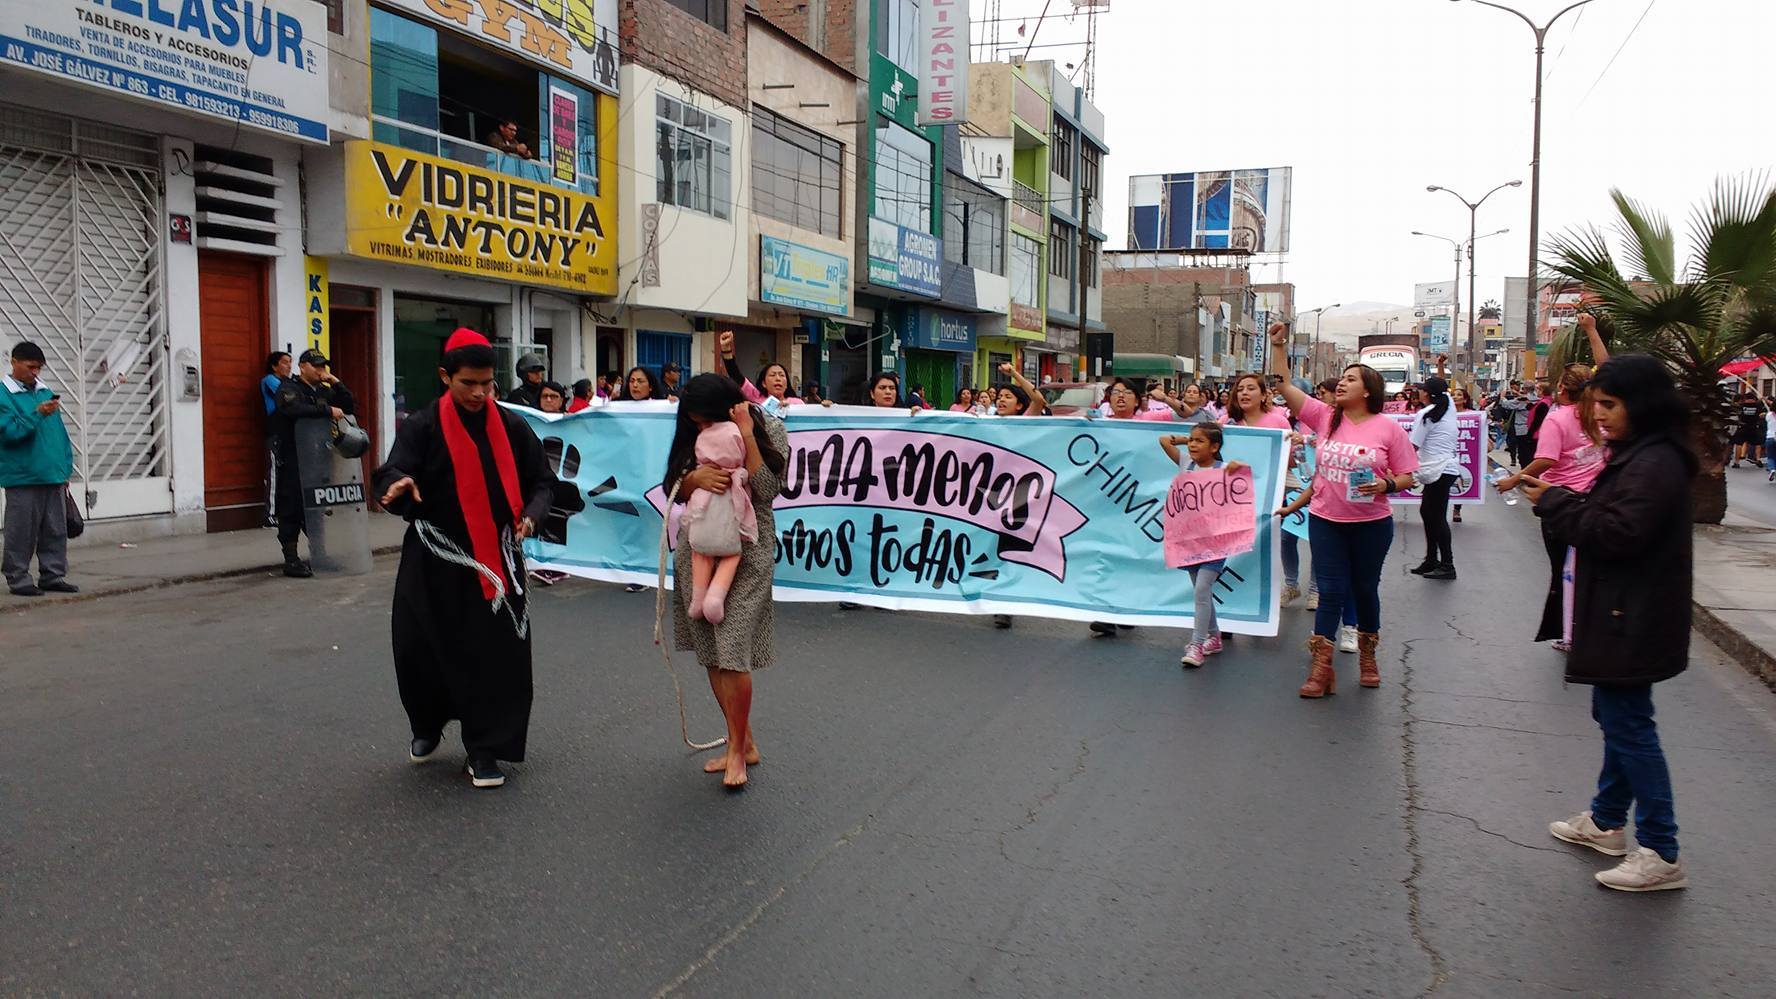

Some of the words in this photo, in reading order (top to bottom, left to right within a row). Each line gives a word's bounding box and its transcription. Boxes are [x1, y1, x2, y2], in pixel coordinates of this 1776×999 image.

[75, 8, 150, 40] TABLEROS
[154, 31, 163, 44] Y
[168, 37, 248, 70] ACCESORIOS
[79, 26, 110, 44] VENTA
[113, 36, 125, 48] DE
[127, 41, 182, 64] ACCESORIOS
[184, 58, 206, 72] PARA
[83, 0, 304, 69] LASUR
[423, 0, 573, 69] GYM
[6, 43, 28, 63] AV.
[31, 50, 63, 72] JOSÉ
[65, 58, 110, 85] GÁLVEZ
[158, 85, 183, 103] CEL.
[192, 72, 239, 96] TAPACANTO
[241, 86, 251, 98] EN
[253, 89, 286, 109] GENERAL
[370, 150, 605, 239] VIDRIERIA
[899, 254, 923, 280] GROUP
[940, 318, 969, 340] hortus
[1369, 351, 1404, 359] GRECIA
[314, 484, 363, 505] POLICIA
[1067, 433, 1245, 605] CHIMBE
